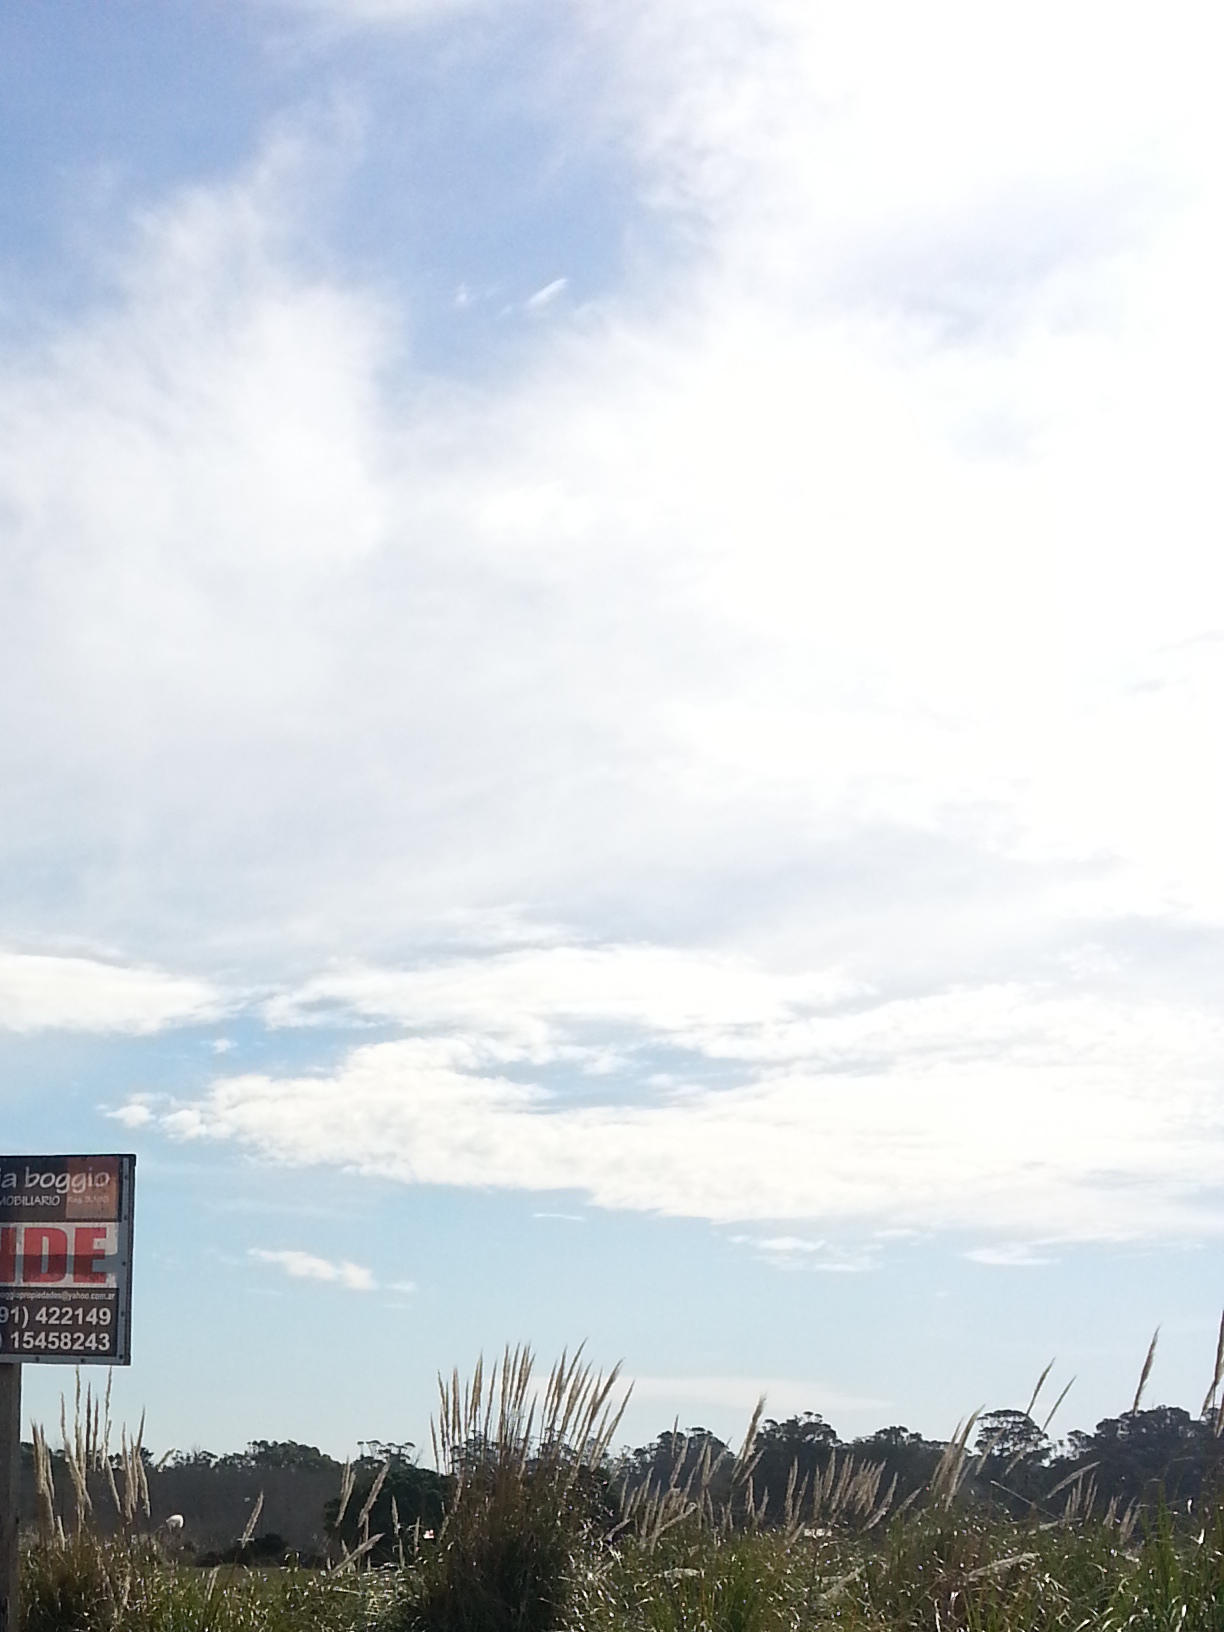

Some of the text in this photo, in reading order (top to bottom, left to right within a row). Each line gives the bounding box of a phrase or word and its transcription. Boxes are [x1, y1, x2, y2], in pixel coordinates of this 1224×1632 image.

[25, 1166, 110, 1194] boggio
[35, 1307, 112, 1325] 422149
[10, 1331, 111, 1351] 15458243
